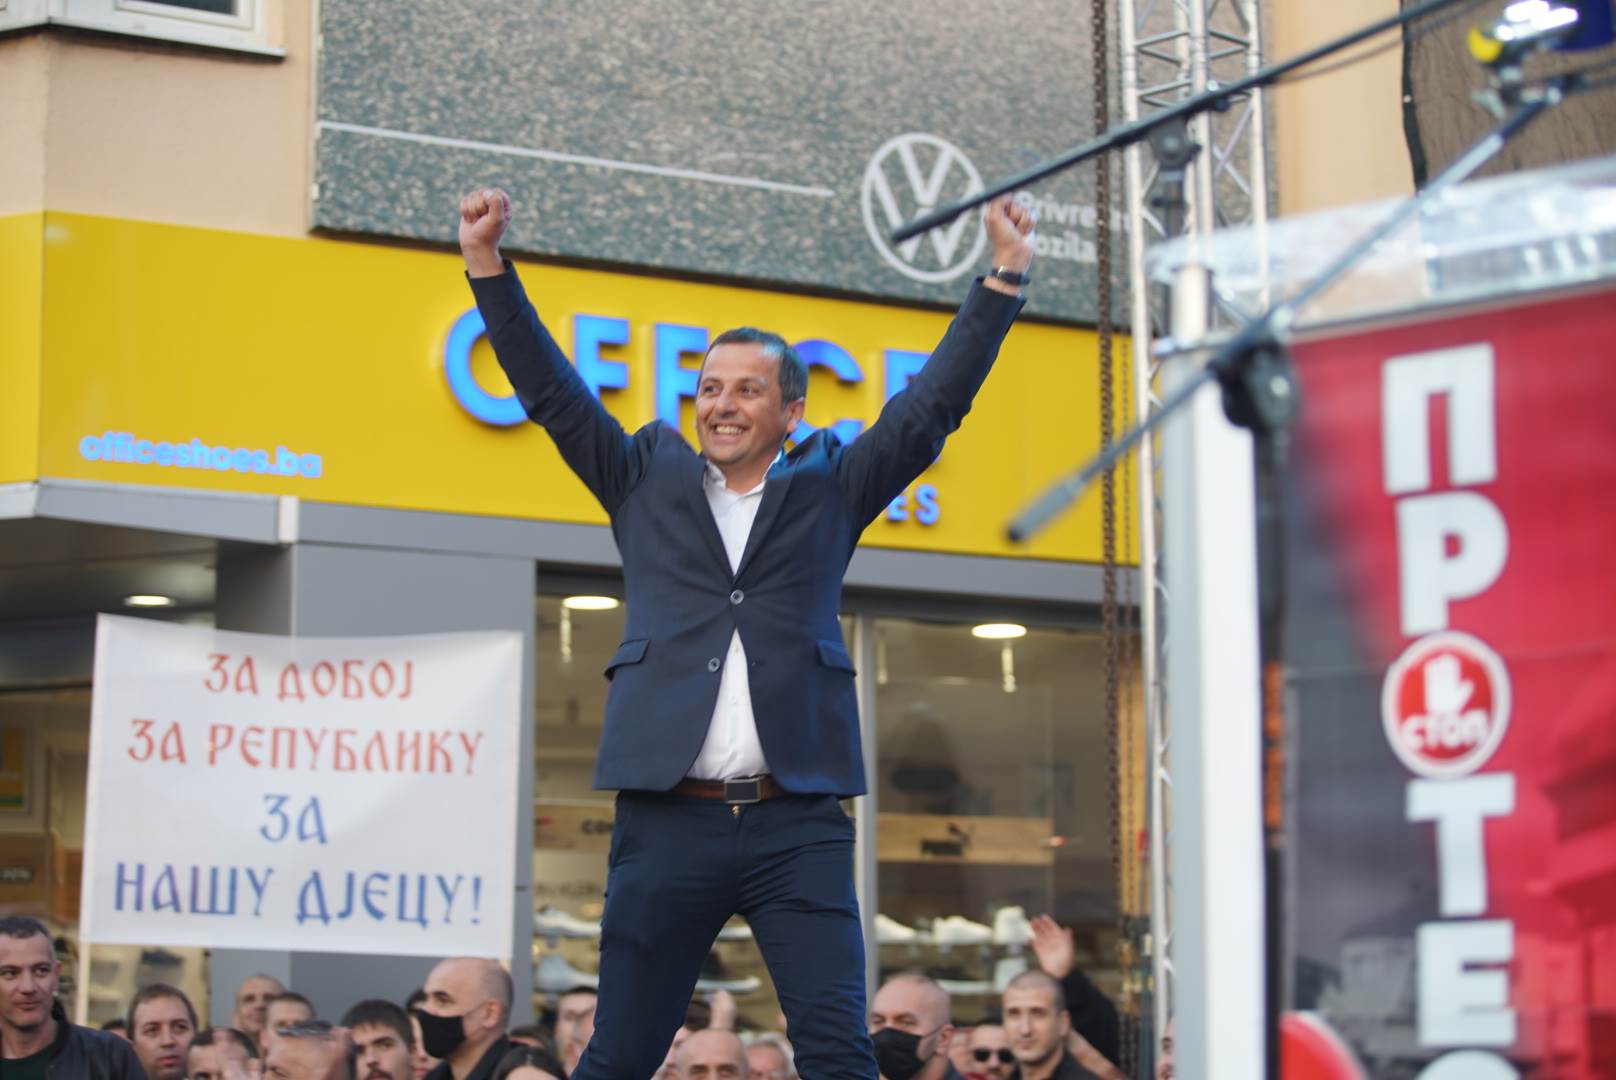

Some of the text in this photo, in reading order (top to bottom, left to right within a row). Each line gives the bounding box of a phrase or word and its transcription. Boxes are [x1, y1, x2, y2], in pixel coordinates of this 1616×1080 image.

[80, 431, 322, 478] officeshoes.ba
[203, 653, 414, 701] ЗА ДОБОЈ
[127, 718, 187, 765] ЗА
[259, 794, 328, 844] ЗА
[114, 862, 275, 916] НАШУ
